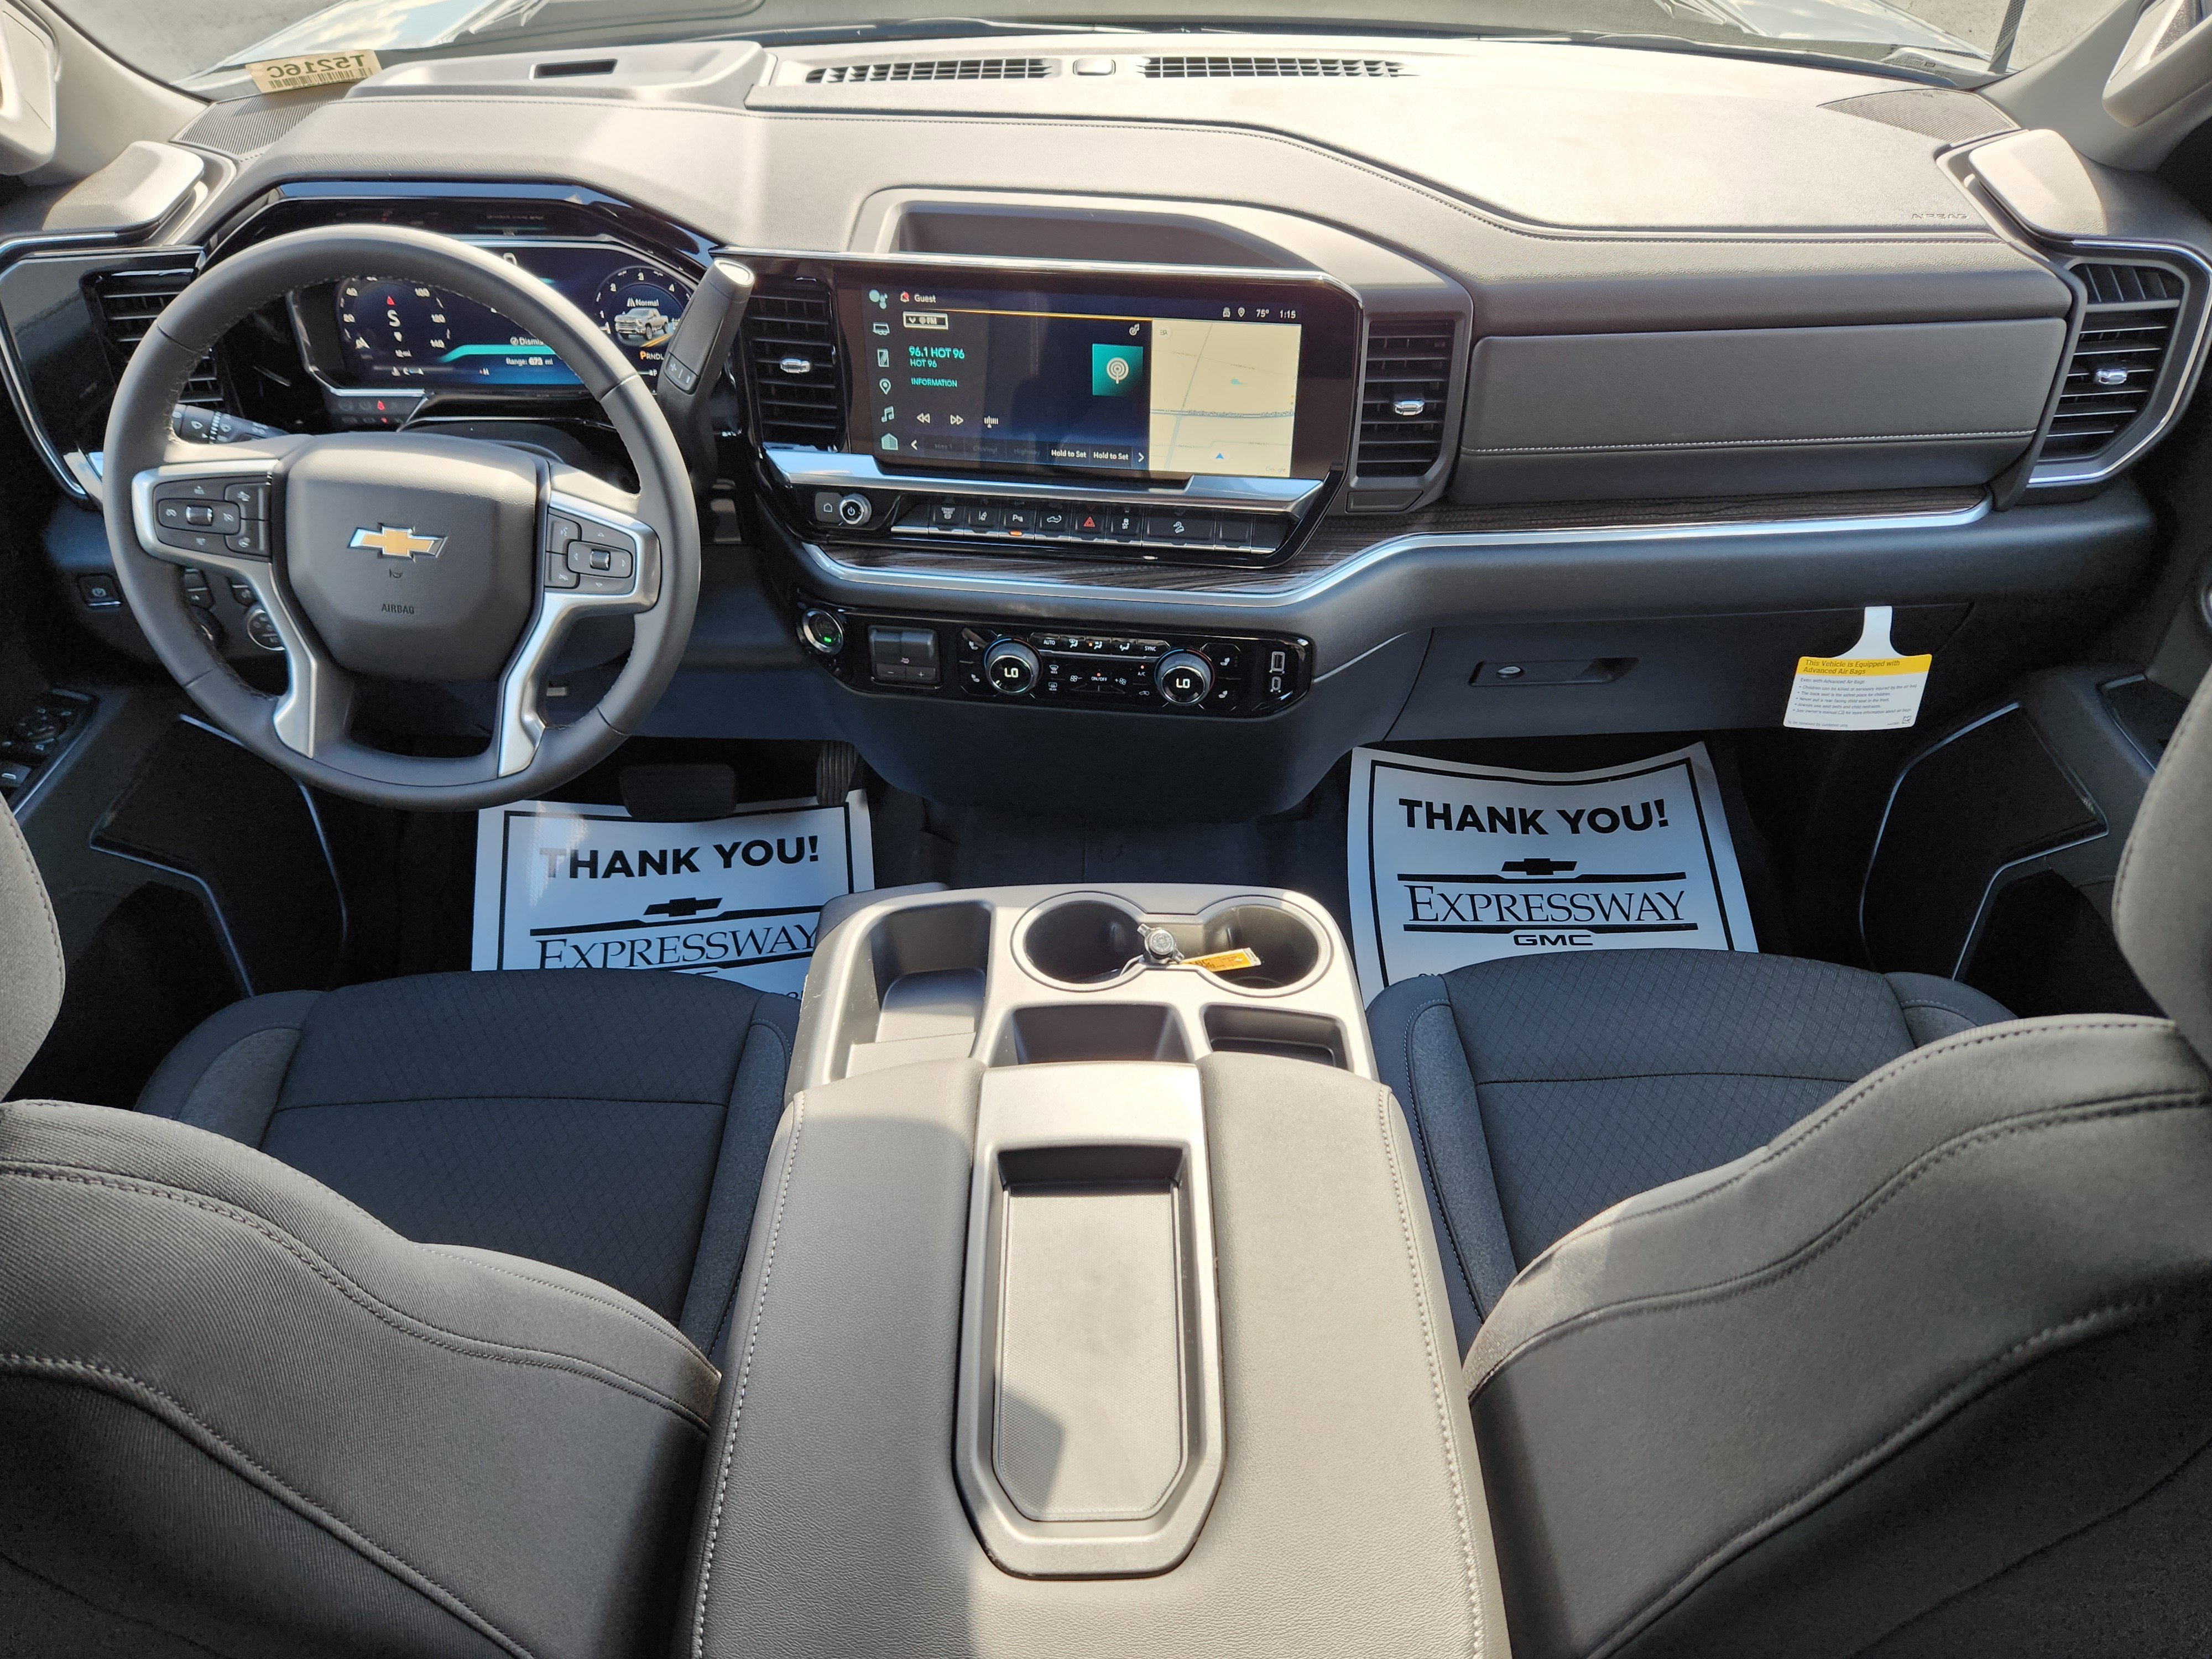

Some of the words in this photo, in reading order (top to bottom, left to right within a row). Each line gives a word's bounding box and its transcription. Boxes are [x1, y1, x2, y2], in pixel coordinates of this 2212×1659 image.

[415, 288, 430, 297] 100
[635, 298, 659, 307] Normal
[914, 293, 936, 304] Guest
[387, 310, 401, 327] S
[1280, 310, 1296, 319] 1:15
[926, 316, 937, 325] FM
[909, 346, 928, 357] 96.1
[931, 347, 952, 358] HOT
[953, 348, 966, 359] 96
[910, 359, 927, 368] HOT
[927, 360, 937, 368] 96
[911, 377, 958, 388] INFORMATION
[382, 603, 414, 614] AIRBAG
[1399, 798, 1548, 835] THANK
[1557, 799, 1670, 835] YOU!
[540, 847, 701, 879] THANK
[712, 835, 820, 869] YOU!
[1403, 884, 1686, 922] EXPRESSWAY
[1513, 933, 1593, 946] GMC
